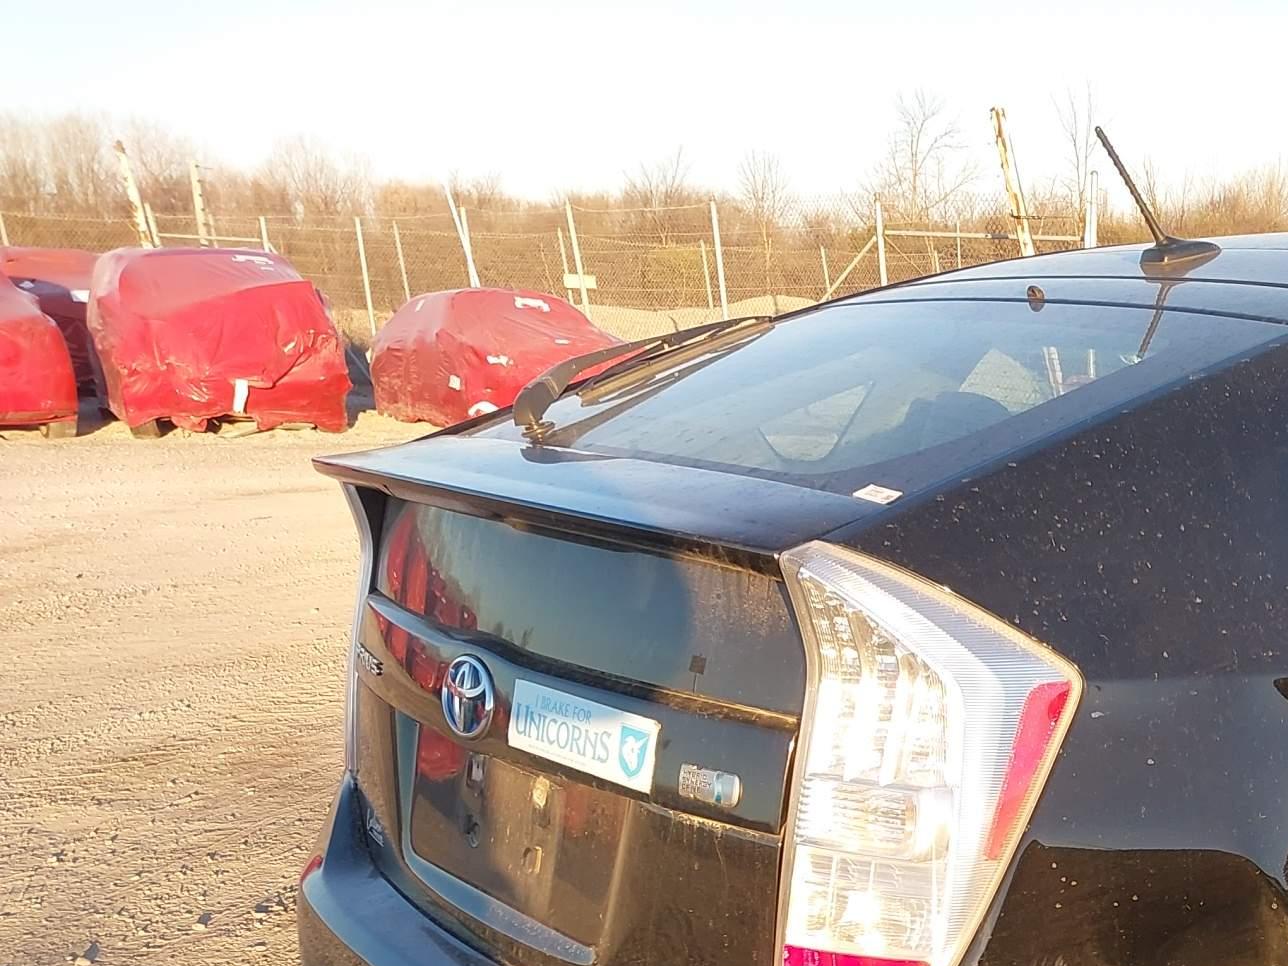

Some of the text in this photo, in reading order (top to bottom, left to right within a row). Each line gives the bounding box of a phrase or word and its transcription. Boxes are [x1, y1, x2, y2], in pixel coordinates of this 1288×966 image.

[535, 693, 592, 725] I BRAKE FOR
[515, 702, 612, 765] UNICORNS
